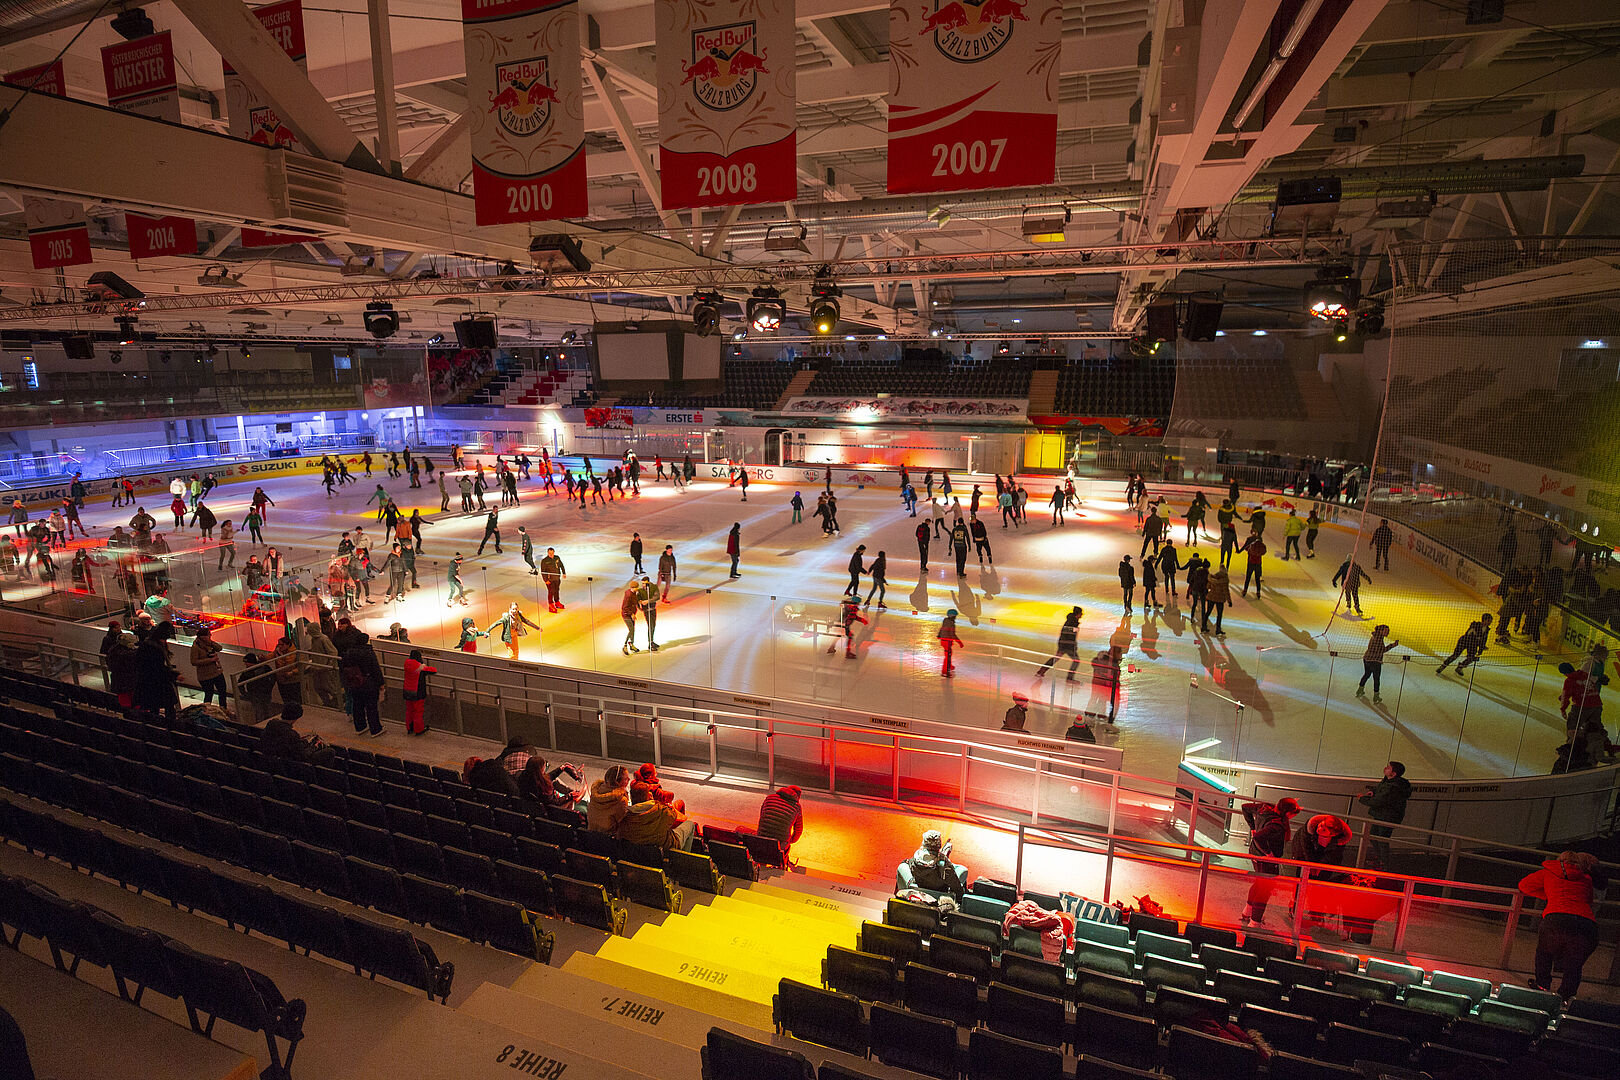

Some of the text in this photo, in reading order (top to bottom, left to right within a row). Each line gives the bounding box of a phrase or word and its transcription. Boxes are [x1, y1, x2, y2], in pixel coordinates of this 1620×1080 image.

[697, 27, 751, 51] Red Bull
[942, 26, 1005, 57] SALZBURG
[112, 43, 163, 66] ÖSTERREICHISCHER
[113, 56, 167, 90] MEISTER
[499, 61, 545, 83] Red Bull
[700, 78, 752, 105] SALZBURG
[252, 112, 269, 126] Red
[504, 107, 546, 132] SALZBURG
[931, 138, 1008, 177] 2007
[697, 163, 757, 197] 2008
[506, 184, 553, 213] 2010
[49, 238, 73, 261] 2015
[146, 226, 176, 251] 2014
[666, 413, 692, 423] ERSTE
[251, 461, 297, 473] SUZUKI
[711, 467, 774, 480] SARG
[2, 488, 69, 505] SUZUKI
[1416, 539, 1449, 568] SUZUKI
[883, 719, 907, 728] STEHPLATZ
[678, 963, 729, 985] REIHE 6
[603, 997, 665, 1026] REIHE 7
[496, 1044, 568, 1080] REIHE 8
